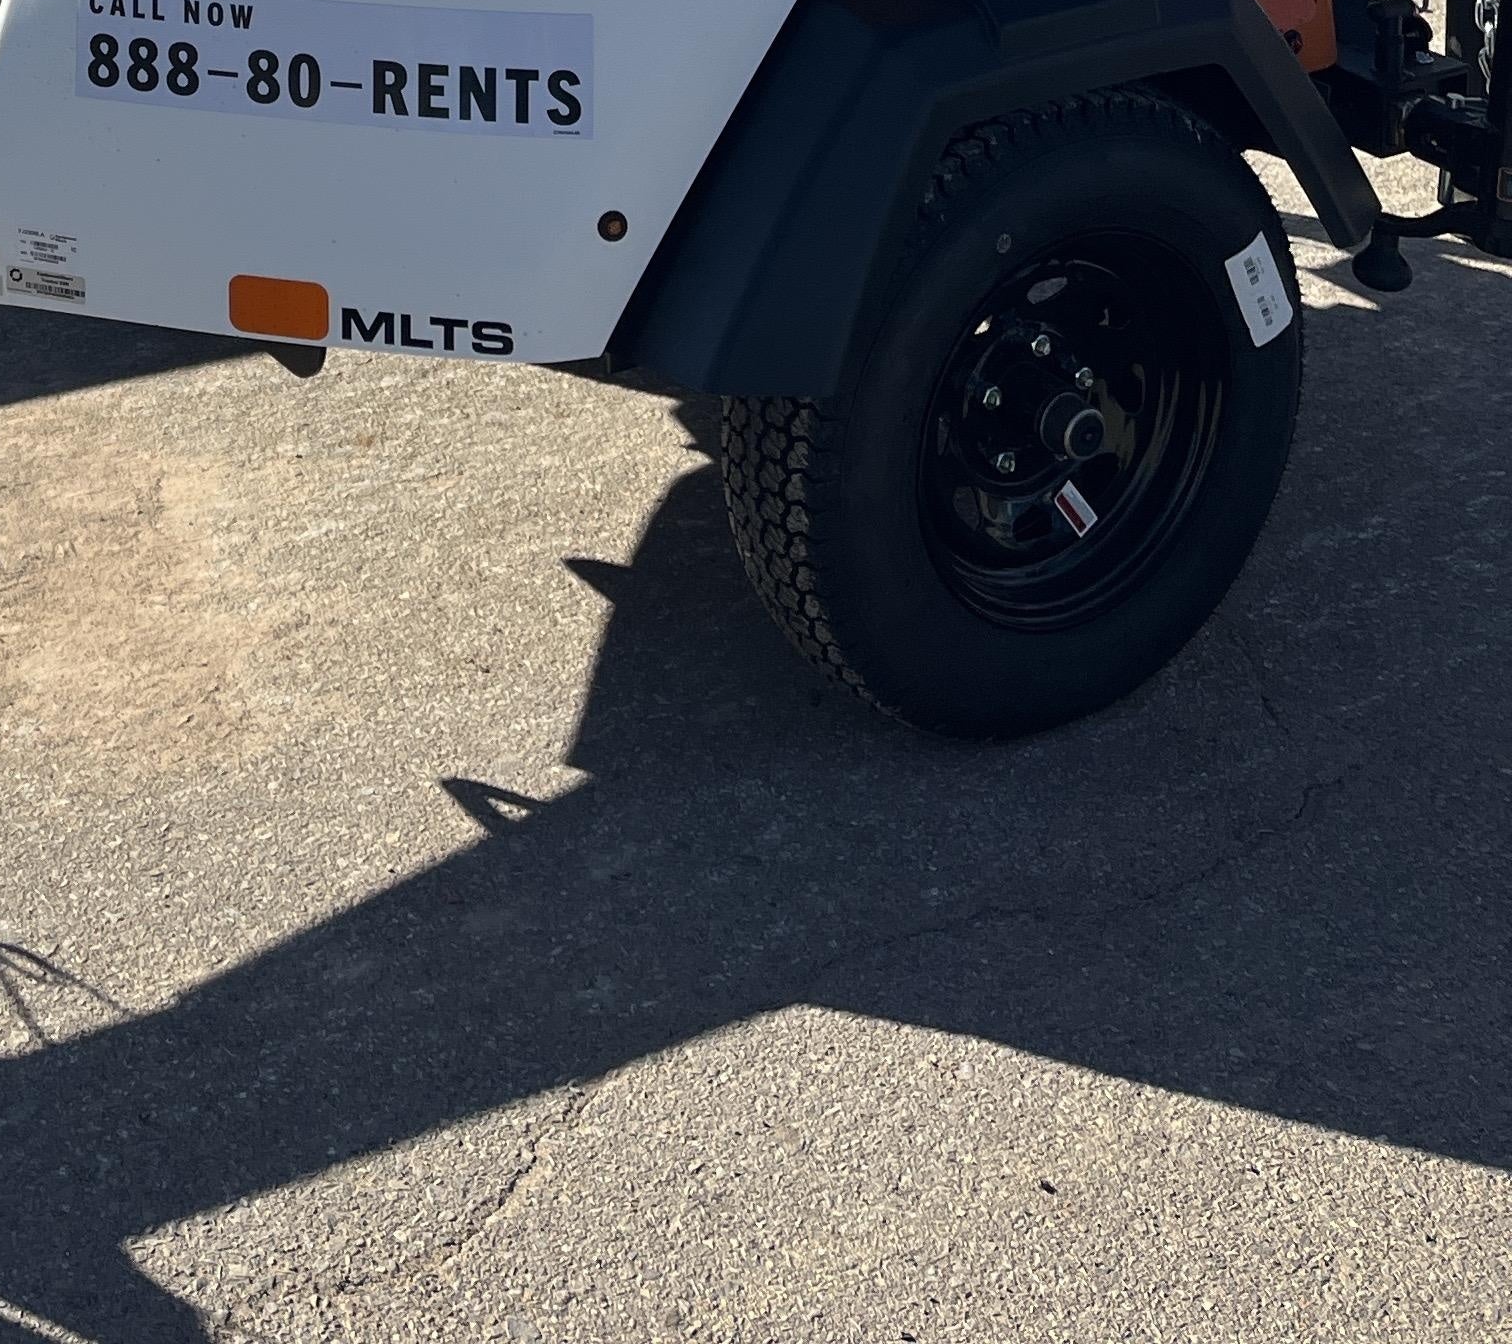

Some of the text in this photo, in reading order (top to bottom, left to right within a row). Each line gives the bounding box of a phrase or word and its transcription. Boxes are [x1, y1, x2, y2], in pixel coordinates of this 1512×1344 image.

[183, 0, 254, 30] NOW
[87, 33, 583, 126] 888-80-RENTS
[341, 307, 514, 356] MLTS
